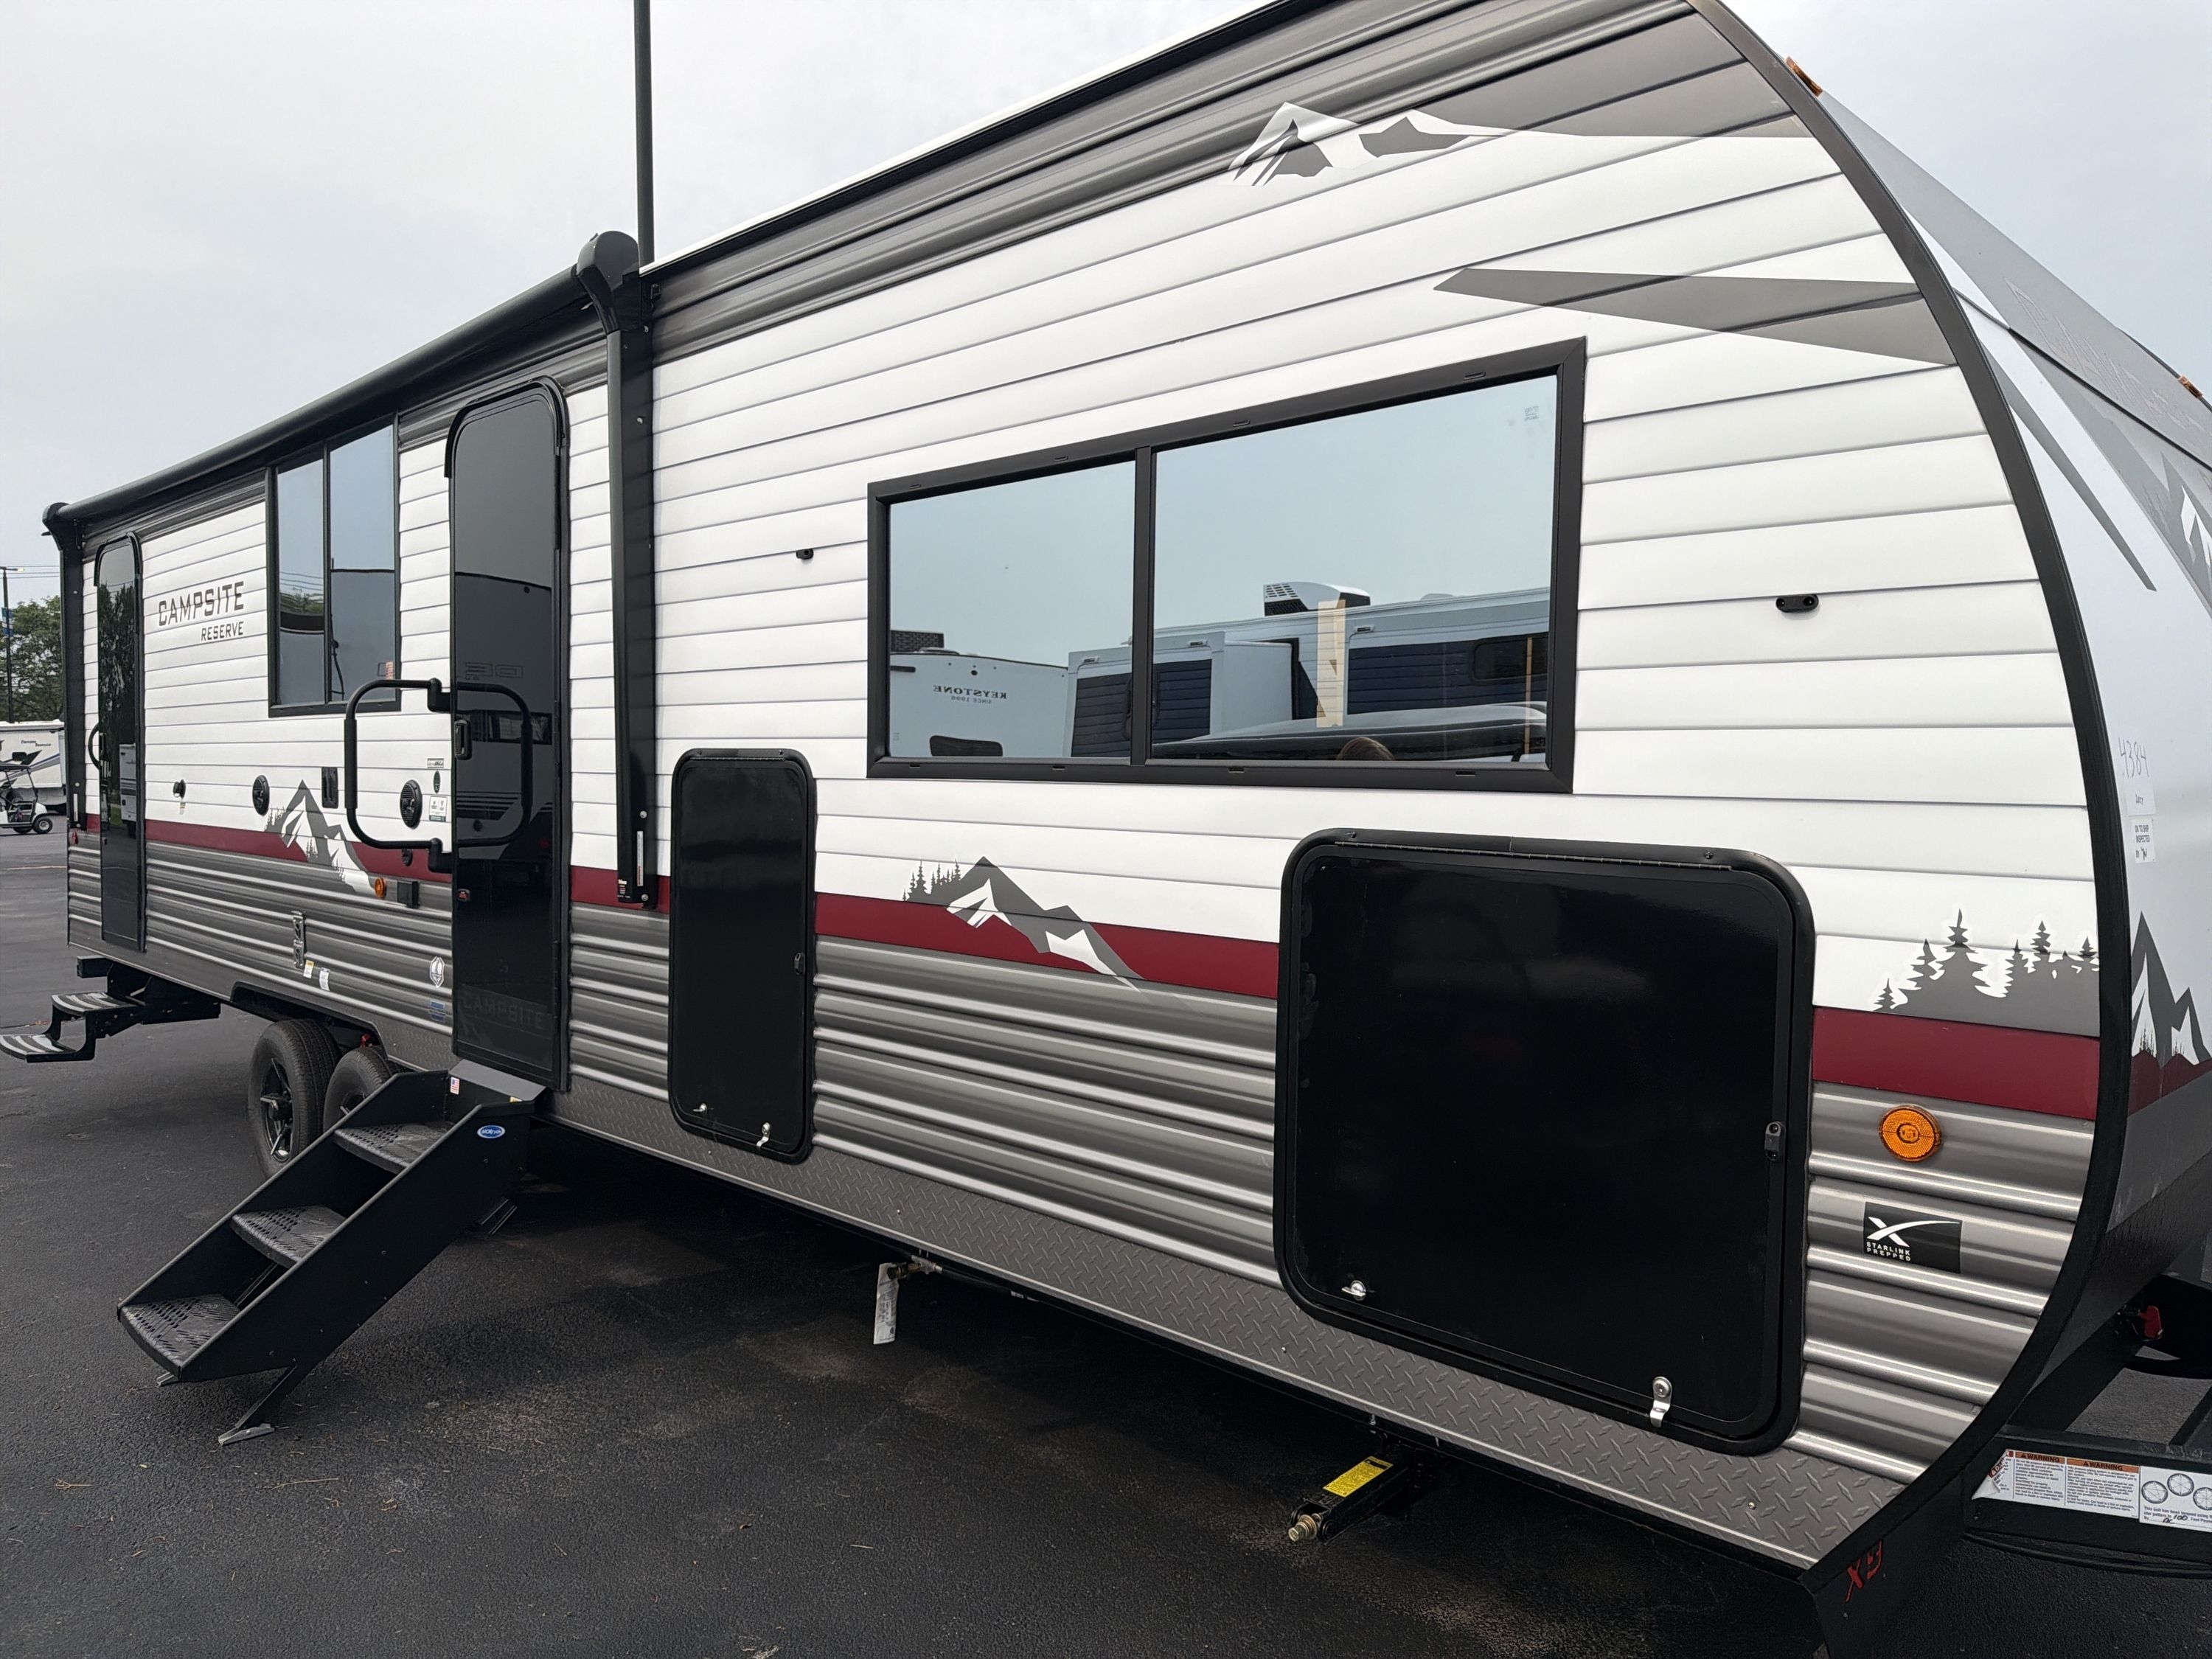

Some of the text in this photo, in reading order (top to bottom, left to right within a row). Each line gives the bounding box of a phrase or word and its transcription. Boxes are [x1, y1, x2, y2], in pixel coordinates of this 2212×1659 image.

[159, 580, 244, 627] CAMPSITE
[201, 621, 244, 641] RESERVE
[2118, 737, 2150, 779] 4384
[1866, 1242, 1910, 1256] STARLINK
[1866, 1248, 1911, 1262] PREPPED
[2026, 1453, 2060, 1462] WARNING
[2089, 1461, 2124, 1471] WARNING
